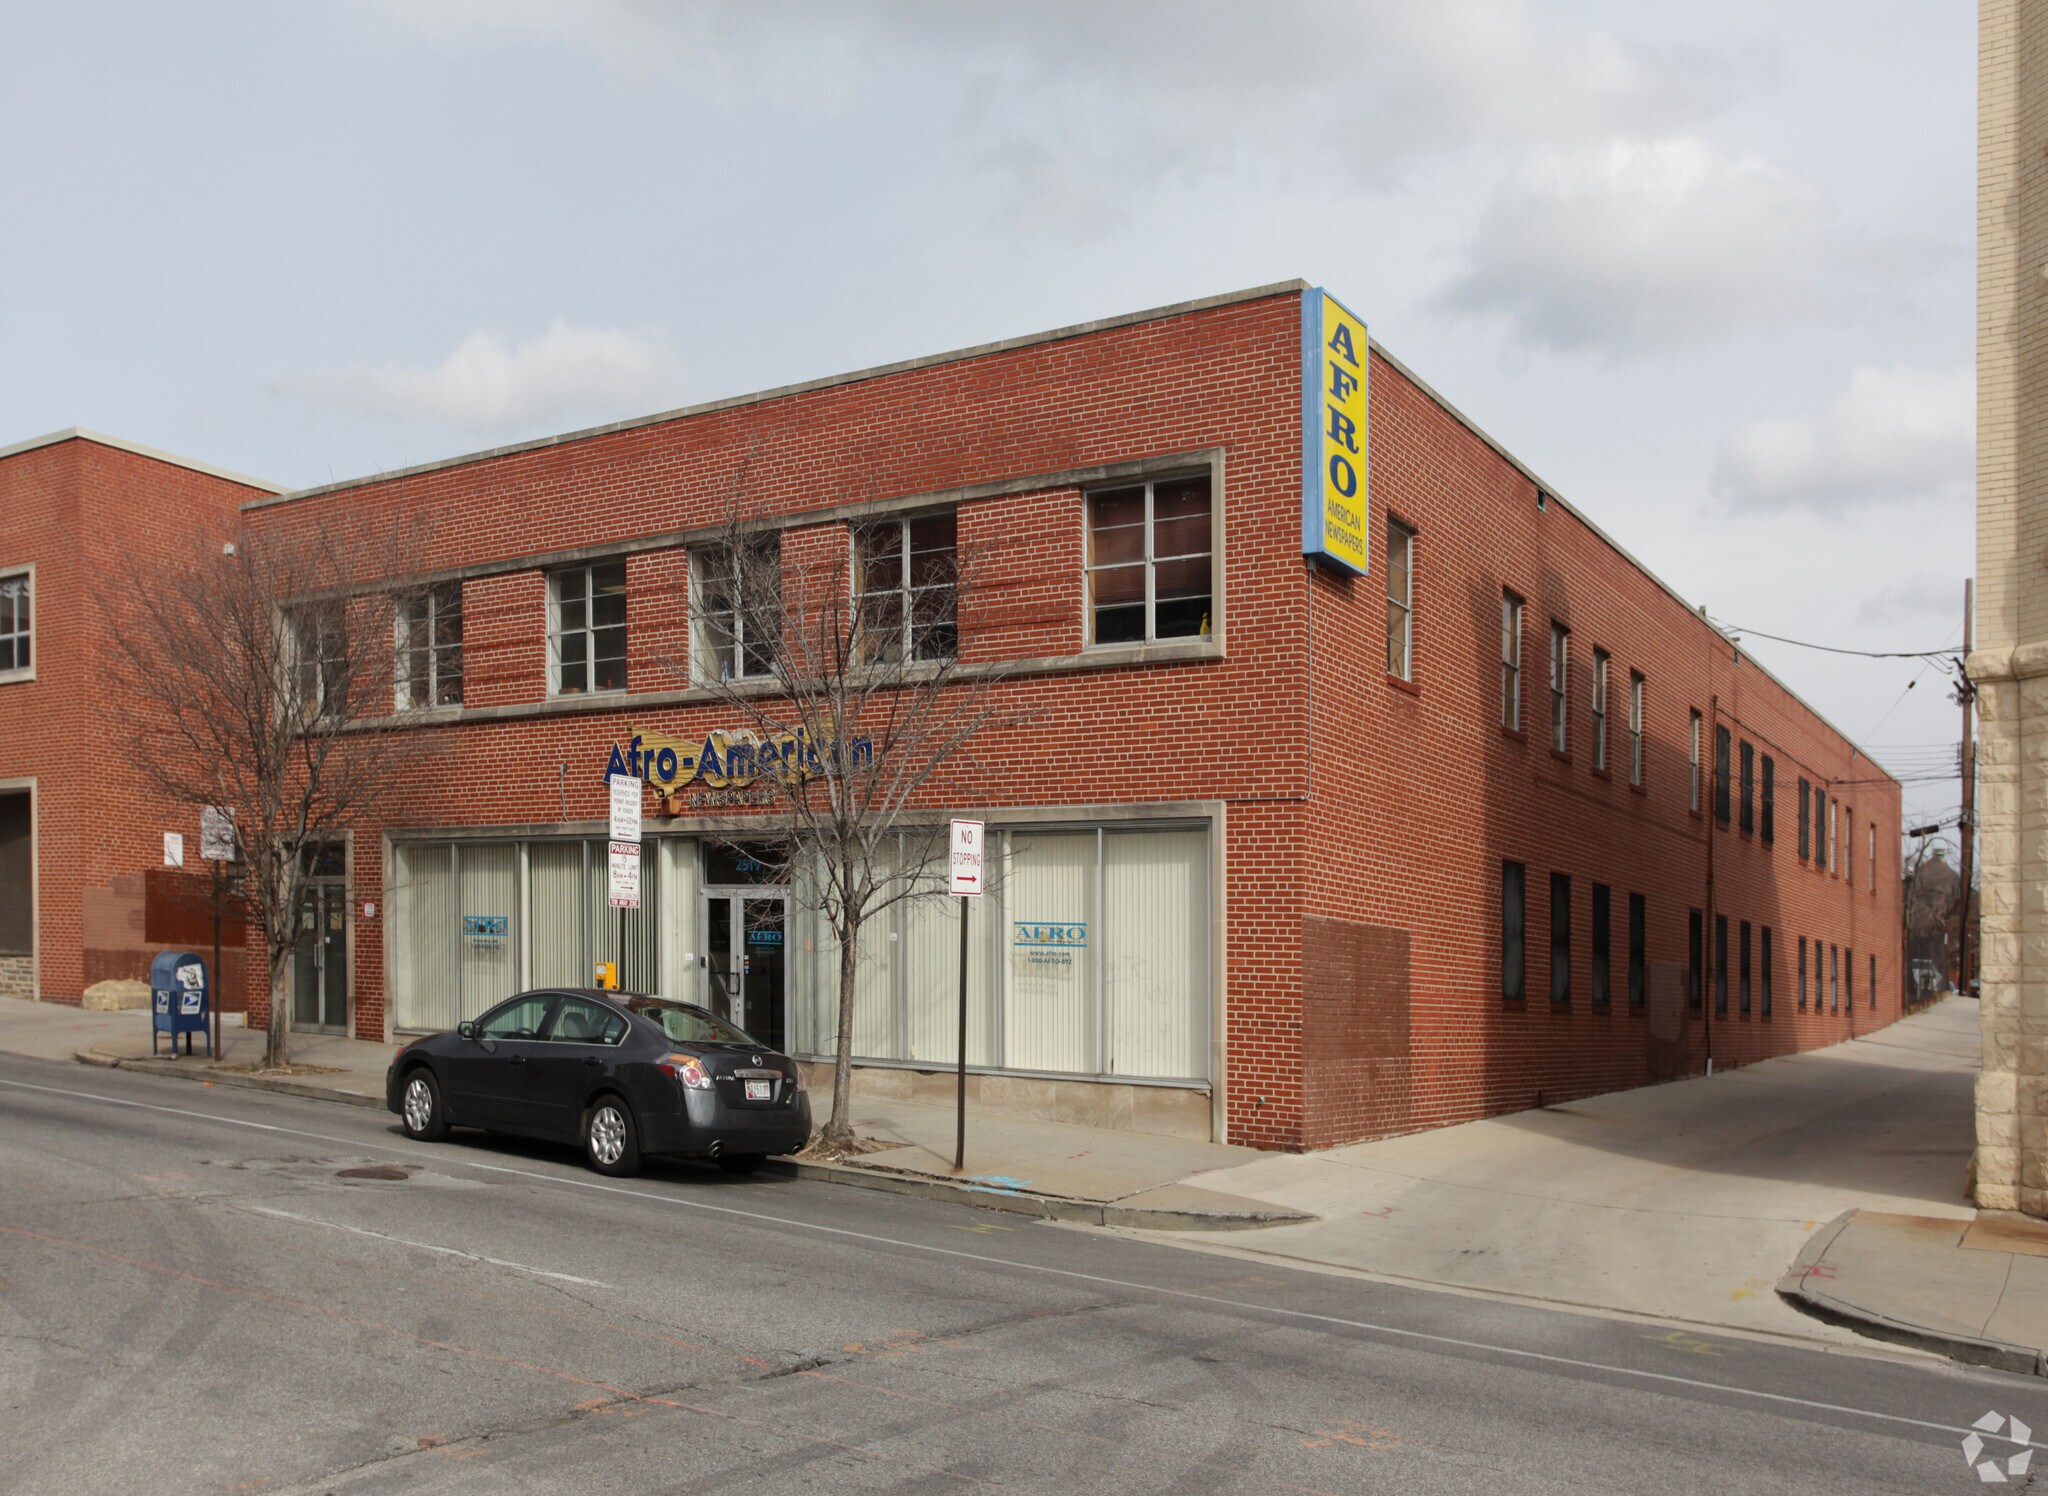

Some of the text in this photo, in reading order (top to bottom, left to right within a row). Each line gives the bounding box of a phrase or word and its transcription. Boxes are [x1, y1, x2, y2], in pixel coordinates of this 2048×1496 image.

[1327, 322, 1360, 499] AFRO
[1327, 499, 1361, 532] AMERICAN
[1325, 518, 1363, 555] NEWSPAPERS
[612, 777, 639, 789] PARKING
[690, 788, 776, 808] NEWSPAPERS
[961, 830, 973, 844] NO
[611, 844, 639, 855] PARKING
[622, 855, 627, 863] 15
[953, 852, 980, 866] STOPPING
[1016, 926, 1086, 940] AFRO
